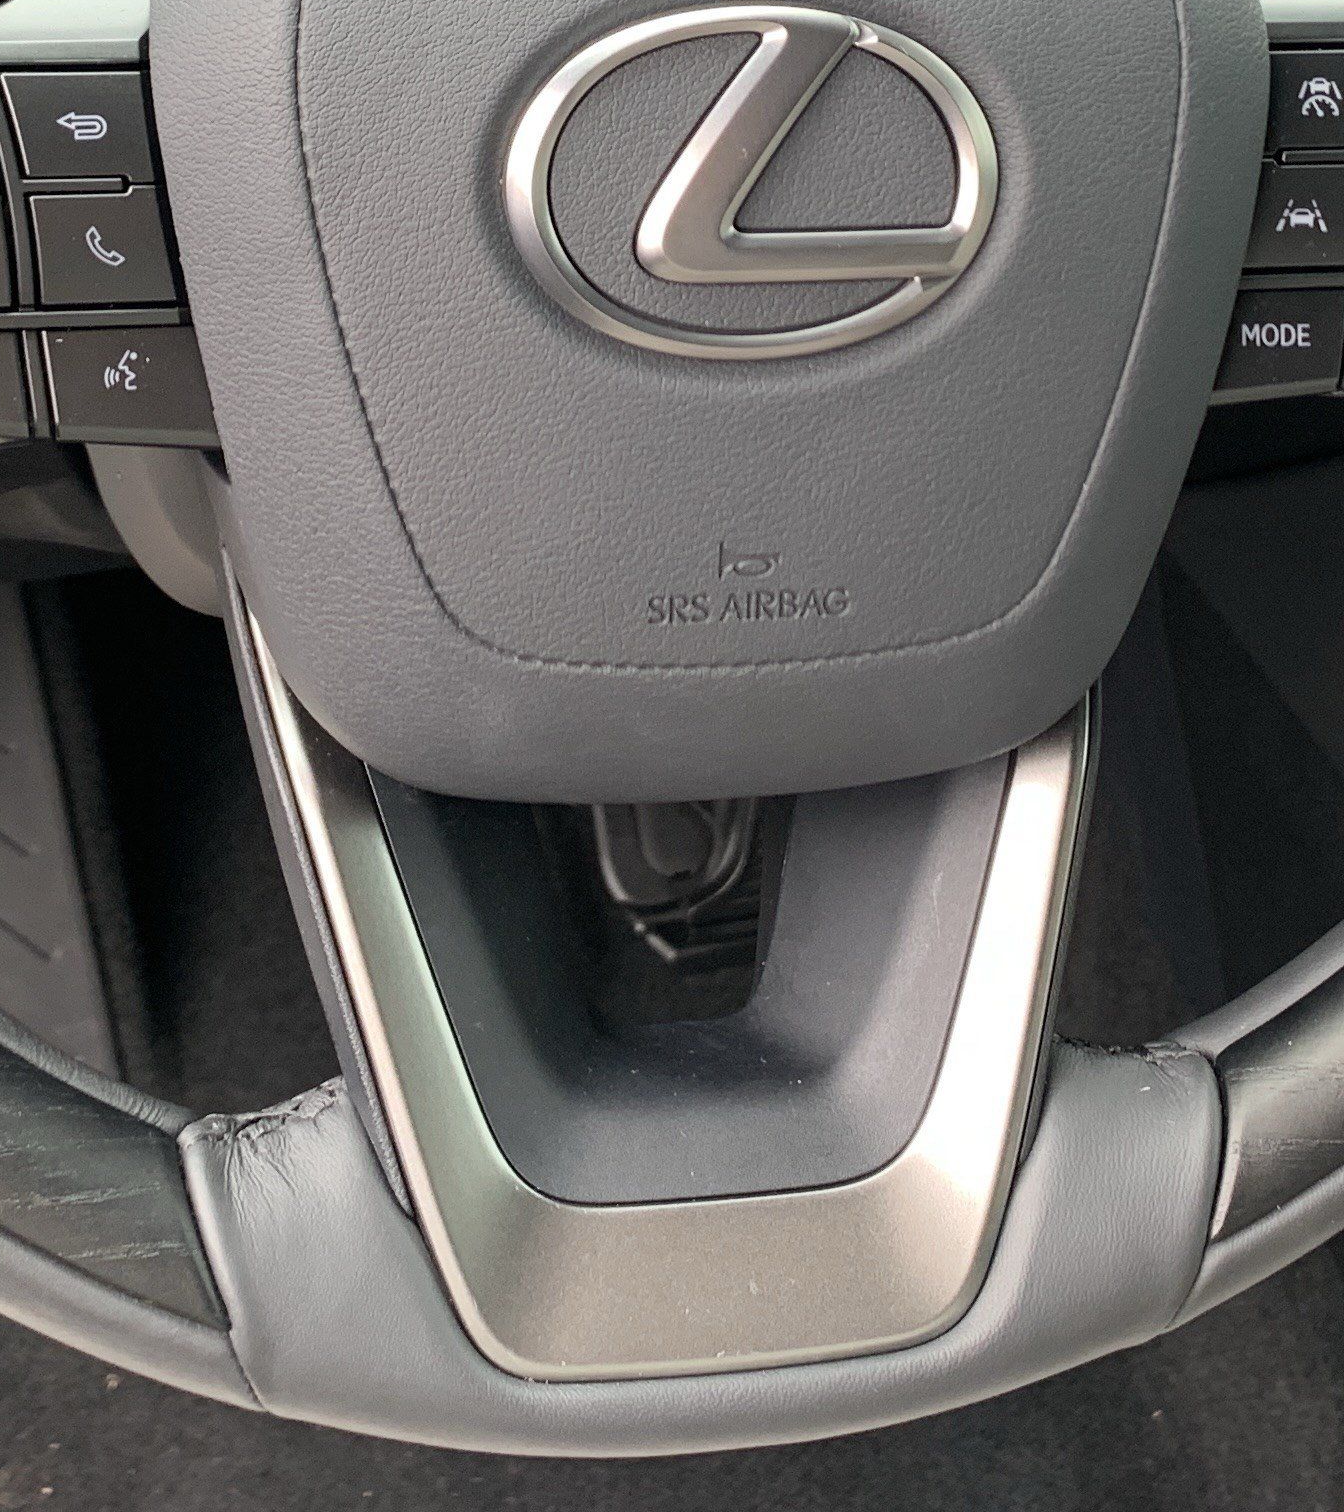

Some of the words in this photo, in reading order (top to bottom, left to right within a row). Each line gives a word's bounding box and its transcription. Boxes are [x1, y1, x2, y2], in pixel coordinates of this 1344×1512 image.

[1241, 324, 1312, 348] MODE
[647, 592, 710, 626] SRS
[719, 587, 852, 624] AIRBAG
